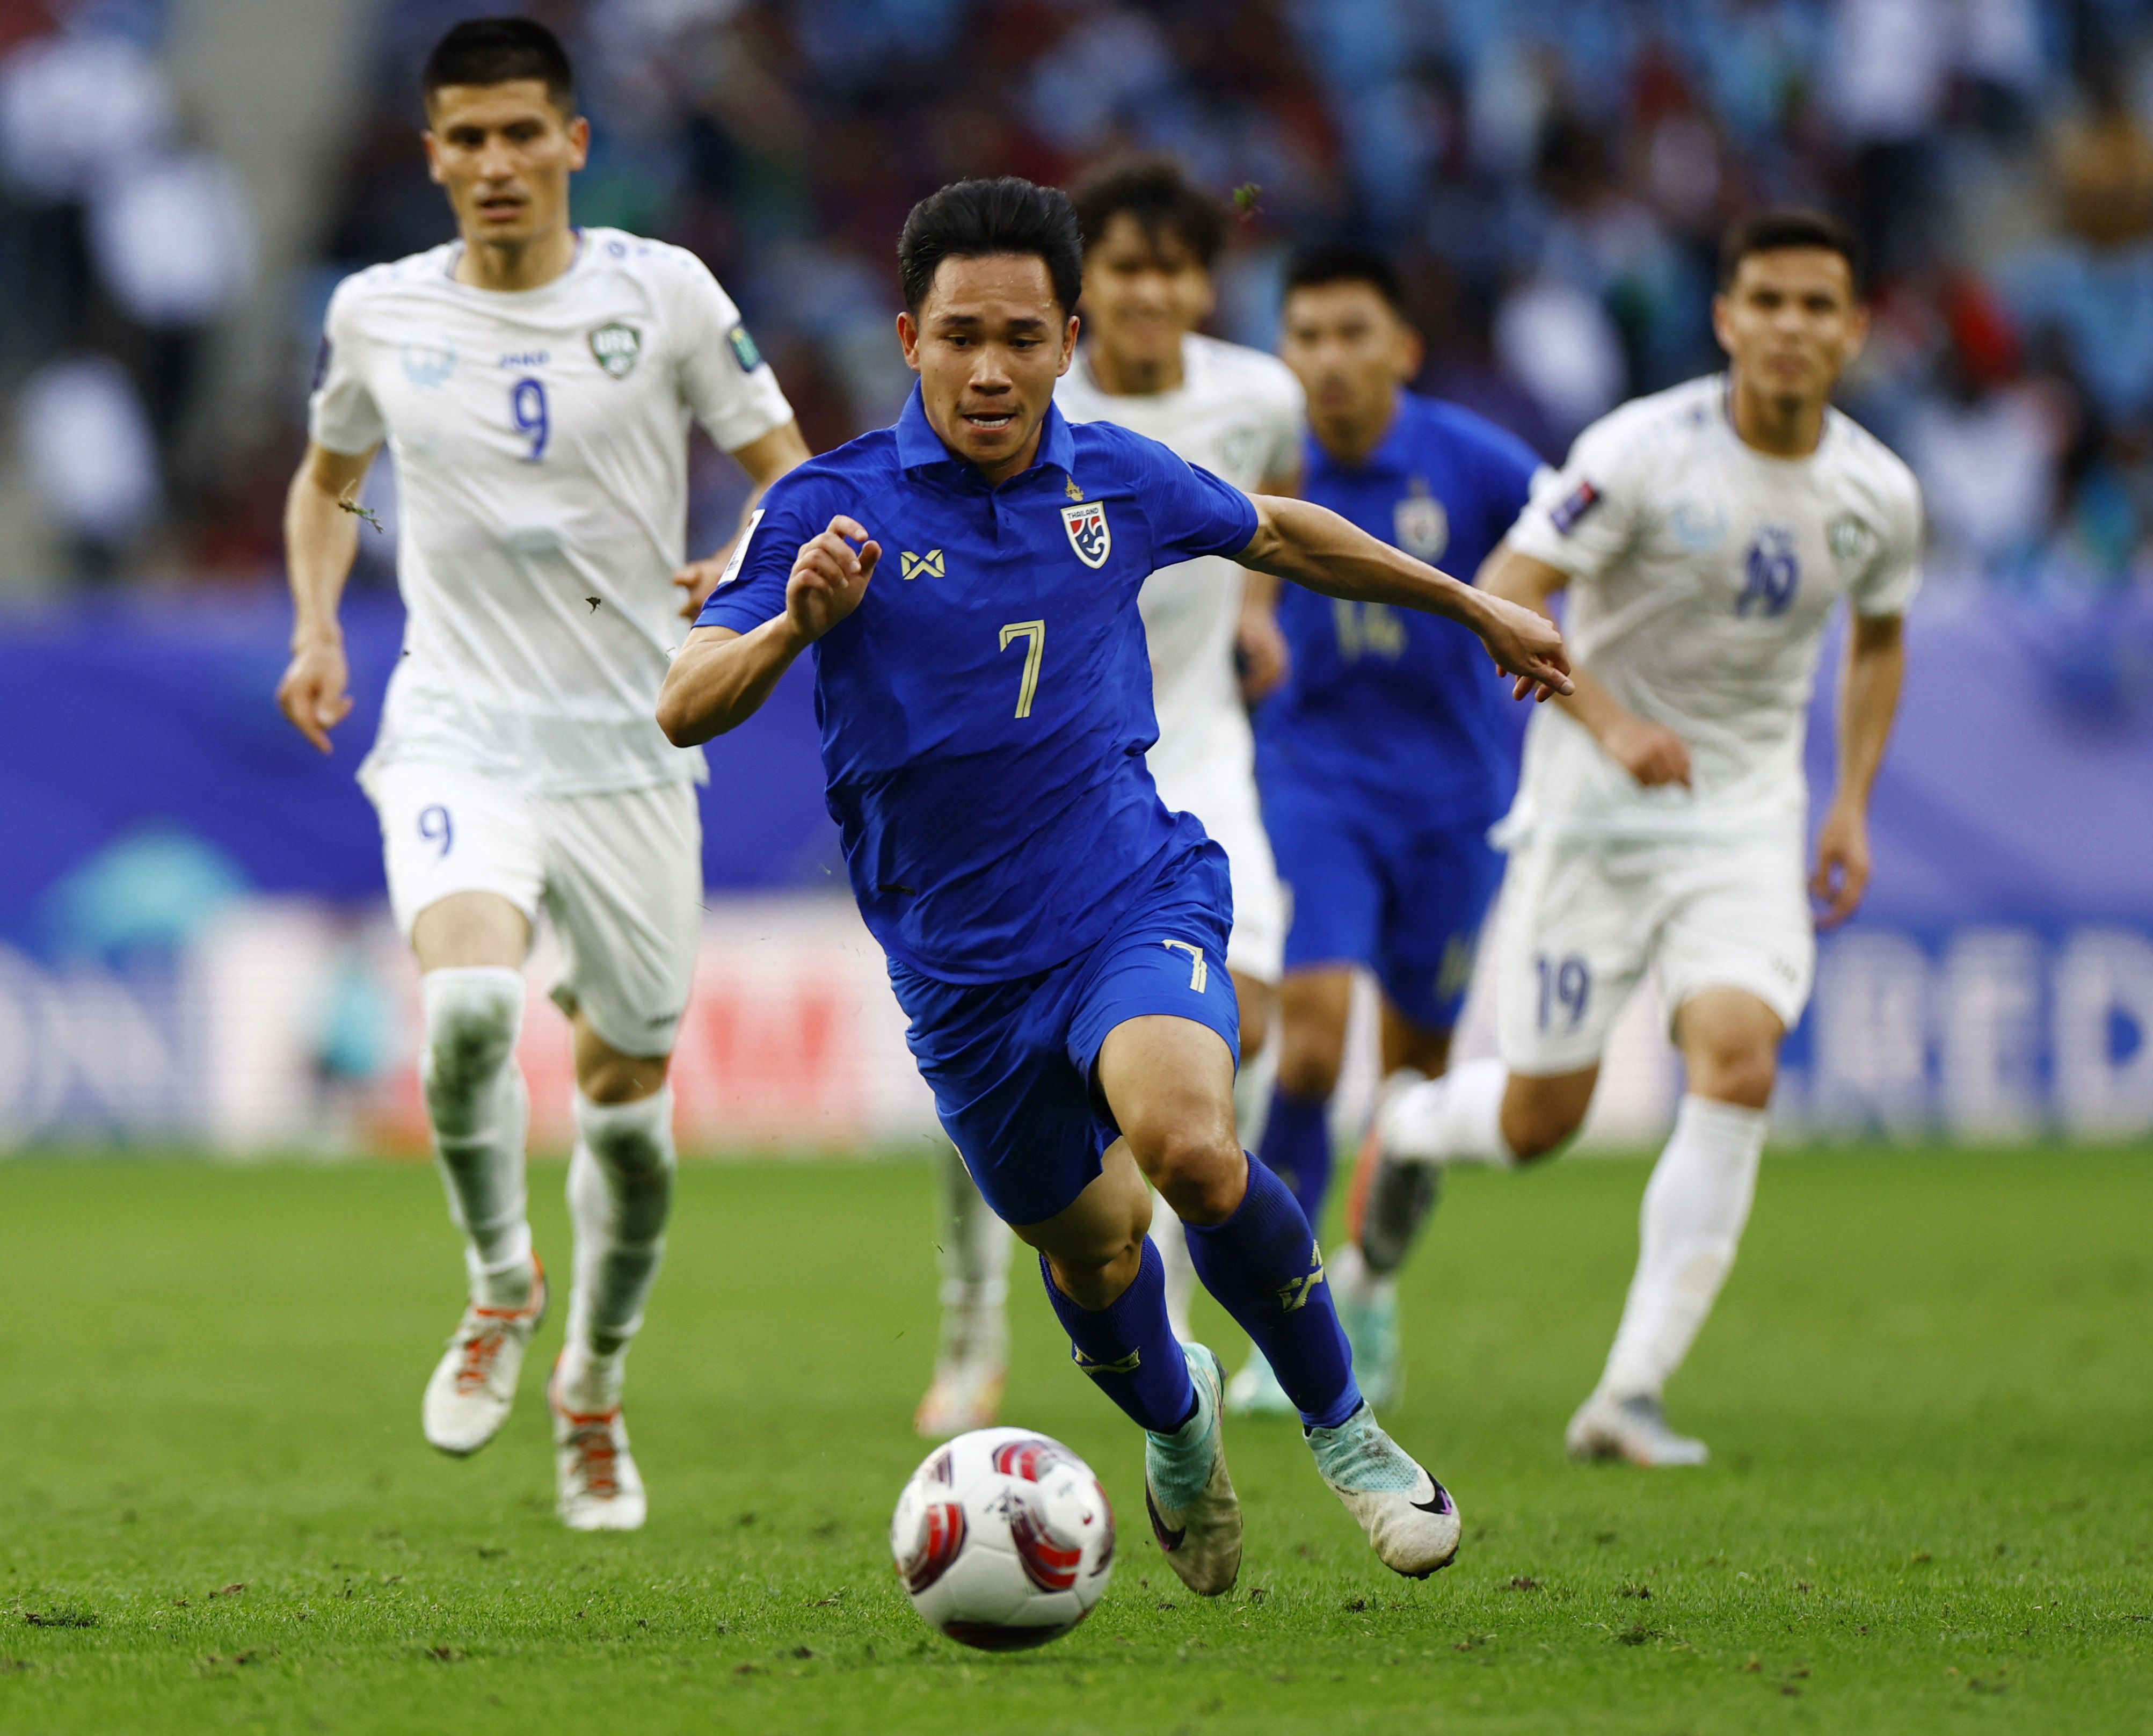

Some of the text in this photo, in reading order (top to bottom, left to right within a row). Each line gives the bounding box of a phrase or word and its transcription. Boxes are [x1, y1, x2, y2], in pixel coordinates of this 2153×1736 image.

[511, 377, 549, 461] 9
[1067, 507, 1099, 519] THAILAND
[999, 620, 1046, 718] 7
[417, 803, 454, 860] 9
[1161, 939, 1208, 994] 7
[1535, 950, 1590, 1034] 19
